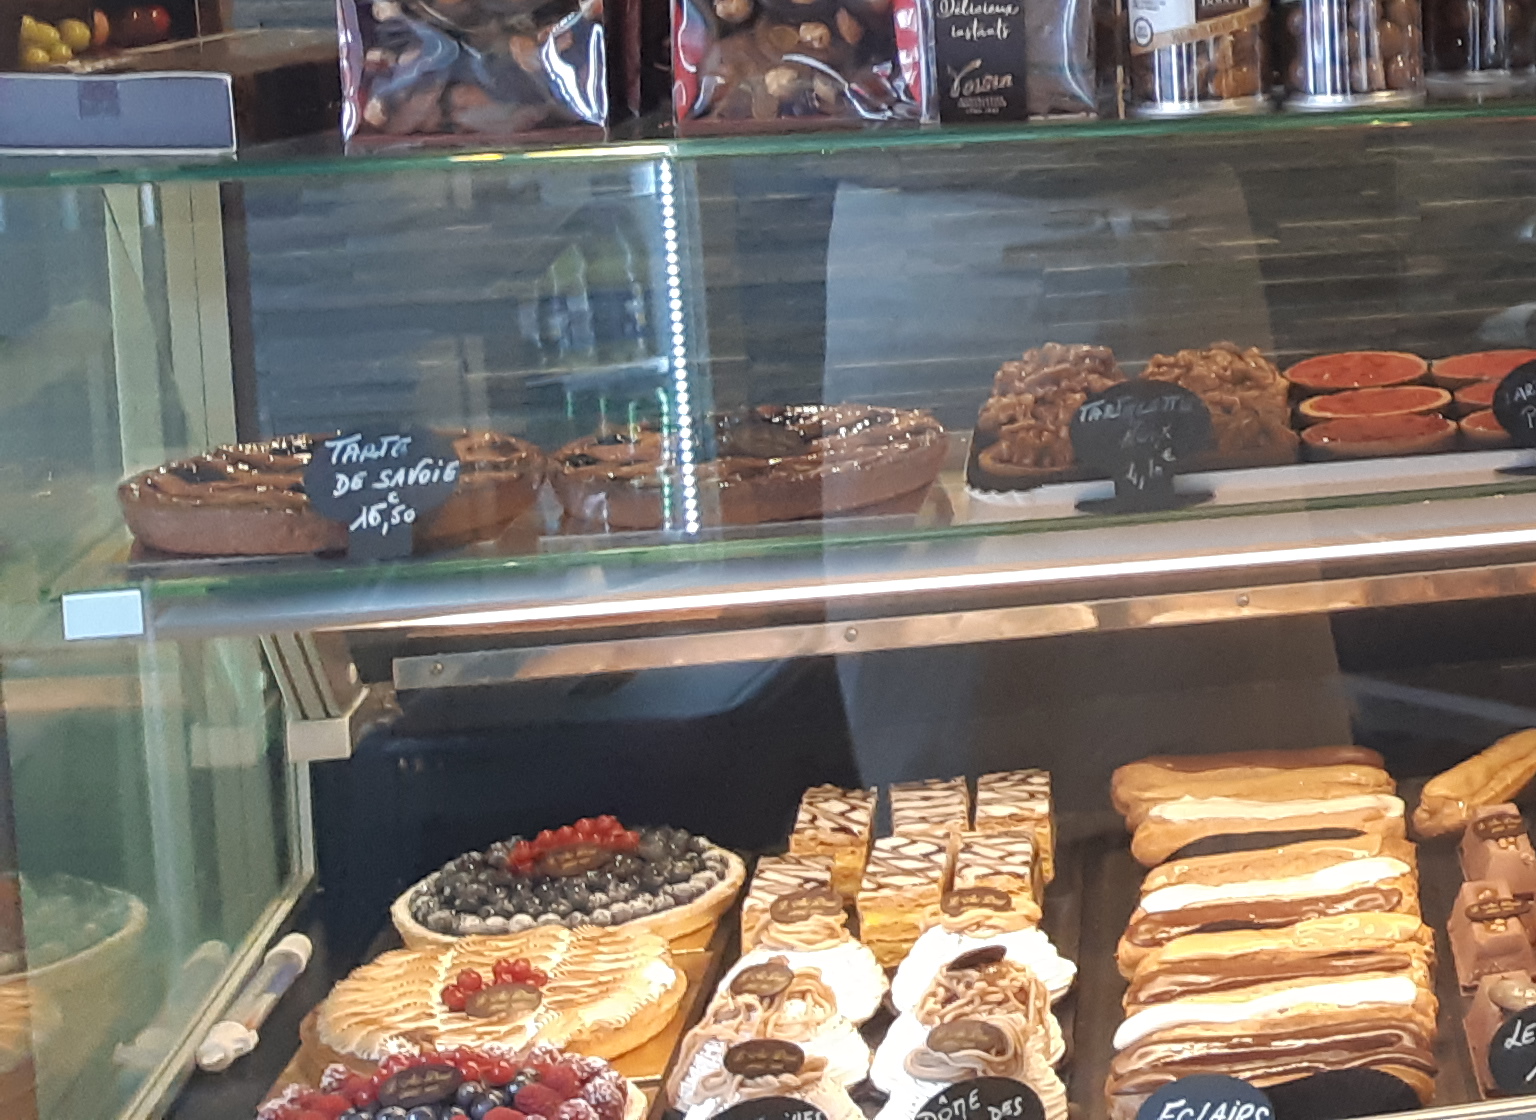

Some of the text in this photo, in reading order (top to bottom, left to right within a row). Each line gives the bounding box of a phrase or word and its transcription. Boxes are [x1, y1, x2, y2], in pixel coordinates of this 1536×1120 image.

[325, 433, 412, 465] TARTE
[333, 457, 459, 498] DE SAVOIE
